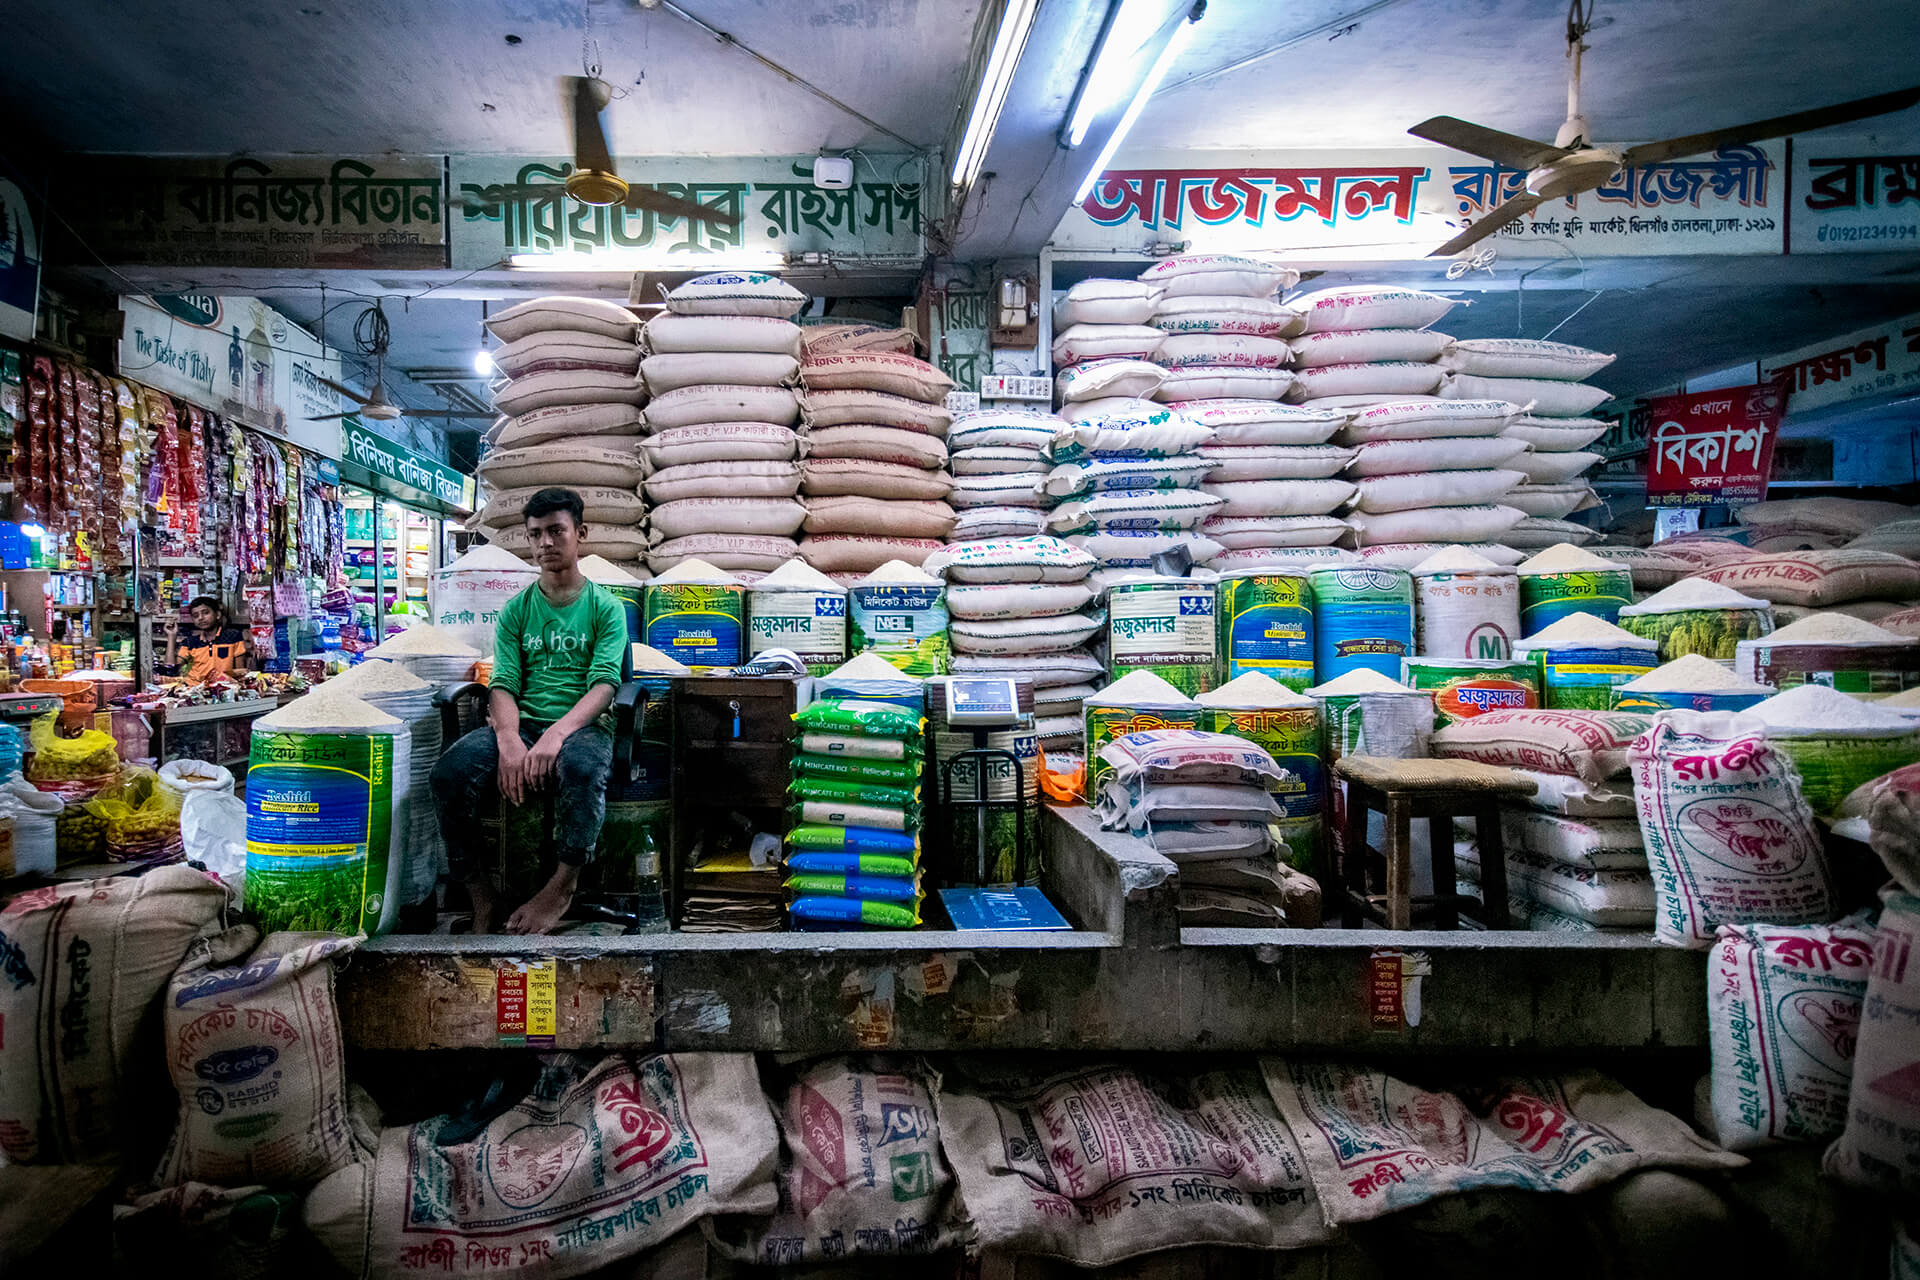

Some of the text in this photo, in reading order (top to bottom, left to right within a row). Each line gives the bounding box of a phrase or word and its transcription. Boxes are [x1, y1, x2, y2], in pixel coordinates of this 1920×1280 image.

[330, 159, 442, 225] বিতান
[1081, 167, 1431, 231] আজমল
[1829, 225, 1917, 242] 01921234994
[136, 330, 217, 395] The Taste of Italy
[1689, 399, 1734, 416] এখানে
[1651, 420, 1770, 475] বিকাশ
[349, 430, 396, 478] বিনিময়
[397, 457, 433, 493] বানিজ্য
[434, 468, 462, 502] বিতান
[1688, 476, 1723, 488] করুন
[594, 489, 635, 504] চাউল
[1540, 583, 1593, 597] মিনিকেট
[863, 595, 929, 608] মিনিকেট চাউল
[678, 628, 713, 639] Rashid
[752, 616, 813, 639] মজুমদার
[1112, 616, 1177, 640] মজুমদার
[1271, 621, 1303, 631] Rashid
[1479, 635, 1501, 660] M
[1457, 687, 1526, 711] মজুমদার
[838, 723, 851, 731] RICE
[374, 743, 384, 785] Rashid
[804, 761, 848, 772] MINICATE RICE
[1241, 752, 1271, 767] চাউল
[266, 788, 312, 804] Rashid
[833, 790, 846, 798] RICE
[1701, 780, 1761, 795] নাজিরশাইল
[296, 802, 319, 813] Rice
[1718, 803, 1753, 818] চিংড়ি
[1639, 794, 1653, 819] ১নং
[1647, 820, 1678, 893] নাজিরশাইল
[1664, 893, 1685, 933] চাউল
[503, 979, 521, 988] কাজ
[530, 981, 553, 989] সালাম
[499, 1021, 525, 1031] দেশপ্রেম
[176, 1001, 300, 1072] মিনিকেট চাউল
[1729, 1000, 1757, 1084] নাজিরশাইল
[1739, 1088, 1768, 1131] চাউল
[811, 1127, 837, 1165] কেজি
[861, 1155, 876, 1189] চাউল
[1171, 1177, 1243, 1207] মিনিকেট
[1247, 1187, 1306, 1209] চাউল
[464, 1242, 513, 1270] পিওর
[519, 1240, 555, 1262] ১নং
[554, 1197, 661, 1251] নাজিরশাইল
[666, 1173, 710, 1210] চাউল
